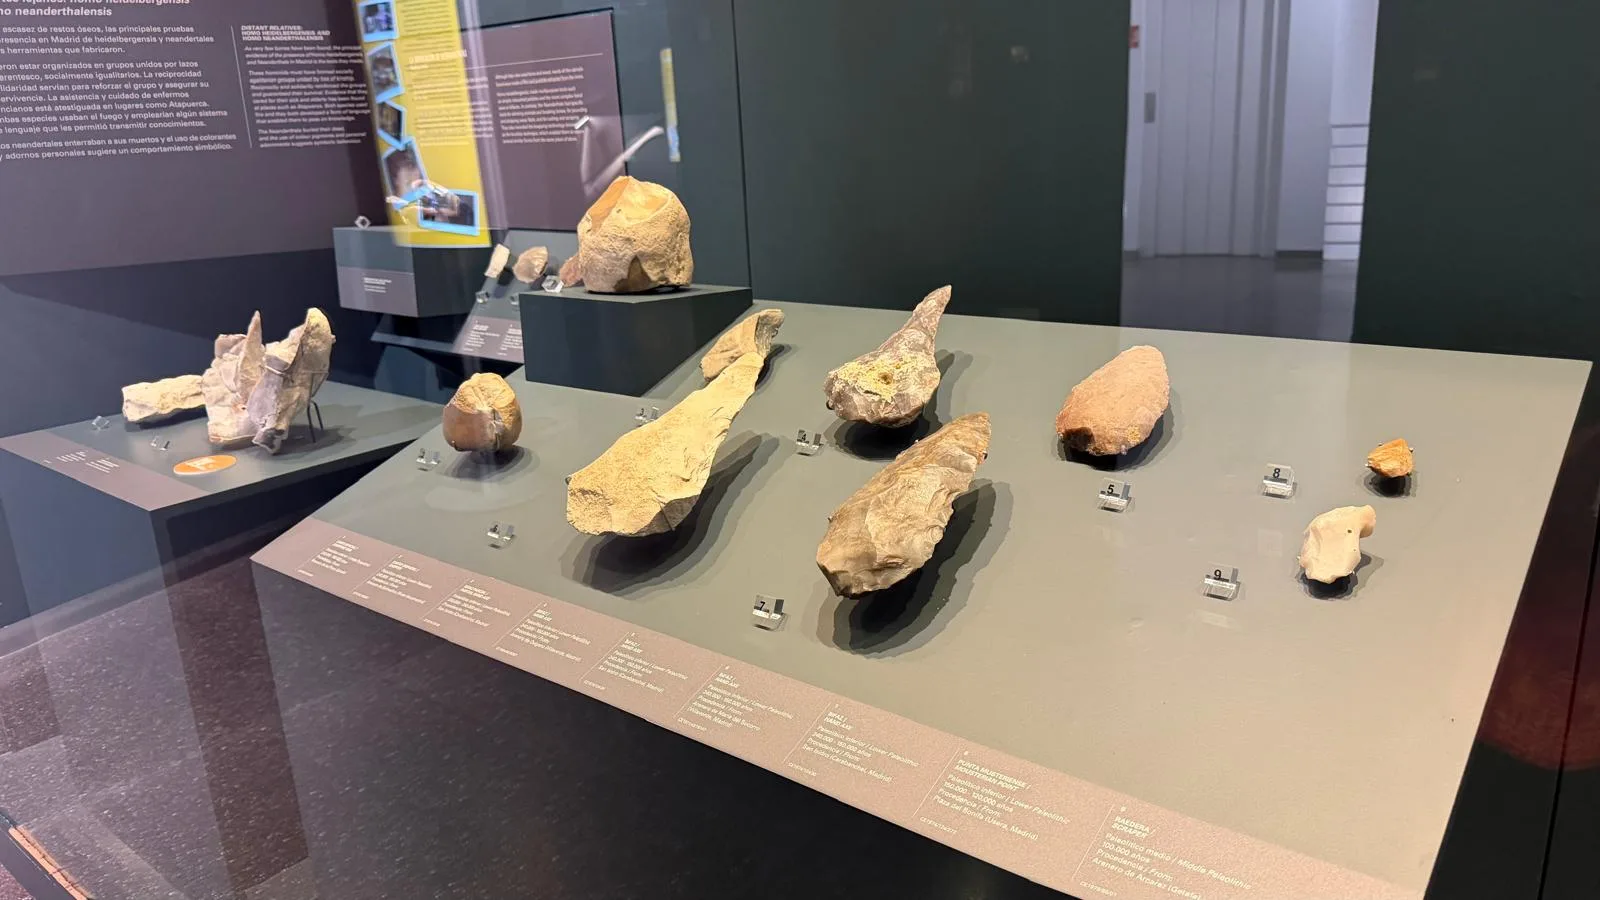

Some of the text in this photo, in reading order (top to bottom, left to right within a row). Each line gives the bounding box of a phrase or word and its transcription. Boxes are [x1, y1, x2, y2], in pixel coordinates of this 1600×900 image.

[15, 6, 112, 16] neanderthalensis
[118, 25, 162, 34] principales
[162, 25, 194, 34] pruebas
[94, 35, 158, 45] heidelbergensis
[158, 36, 164, 44] y
[64, 47, 80, 55] que
[42, 61, 92, 71] organizados
[106, 62, 134, 70] grupos
[164, 61, 177, 70] por
[44, 72, 94, 80] socialmente
[95, 71, 142, 81] igualitarios.
[155, 70, 202, 80] reciprocidad
[72, 83, 90, 92] para
[92, 81, 122, 89] reforzar
[133, 82, 157, 90] grupo
[158, 82, 164, 90] y
[165, 81, 198, 90] asegurar
[60, 92, 100, 101] asistencia
[100, 93, 106, 102] y
[108, 91, 140, 99] cuidado
[153, 90, 189, 98] enfermos
[54, 102, 100, 113] atestiguada
[114, 101, 144, 111] lugares
[168, 100, 210, 110] Atapuerca.
[22, 114, 58, 124] especies
[60, 113, 88, 121] usaban
[100, 112, 122, 122] fuego
[124, 113, 130, 121] y
[176, 110, 198, 120] algún
[198, 108, 228, 117] sistema
[4, 125, 40, 135] lenguaje
[42, 125, 58, 134] que
[74, 122, 108, 133] permitió
[110, 121, 148, 130] transmitir
[148, 119, 206, 128] conocimientos.
[12, 139, 64, 149] neandertales
[64, 137, 106, 146] enterraban
[128, 135, 160, 144] muertos
[160, 136, 166, 145] y
[199, 132, 237, 141] colorantes
[6, 150, 40, 159] adornos
[42, 148, 86, 159] personales
[87, 147, 117, 157] sugiere
[130, 143, 194, 156] comportamiento
[1272, 468, 1280, 478] 8
[1107, 484, 1114, 494] 5
[1214, 570, 1222, 580] 9
[760, 600, 765, 610] 7
[958, 759, 1026, 787] PUNTA MUSTERIENSE
[997, 780, 1019, 791] POINT
[938, 789, 1003, 816] Procedencia From:
[943, 782, 968, 794] 150.000
[996, 803, 1014, 812] años
[981, 787, 1006, 800] inferior
[1010, 799, 1032, 810] Lower
[932, 796, 951, 806] Plaza
[984, 817, 1010, 829] (Usera,
[1010, 827, 1039, 839] Madrid)
[1115, 816, 1151, 834] RAEDERA
[1112, 822, 1146, 839] SCRAPER
[1102, 840, 1150, 864] 100.000 años
[1097, 849, 1173, 882] Procedencia From:
[1146, 848, 1171, 861] medio
[1177, 859, 1207, 874] Middle
[1207, 870, 1252, 890] Paleolithic
[1092, 857, 1124, 873] Arenero
[1124, 869, 1136, 878] de
[1167, 885, 1201, 900] (Getafe)
